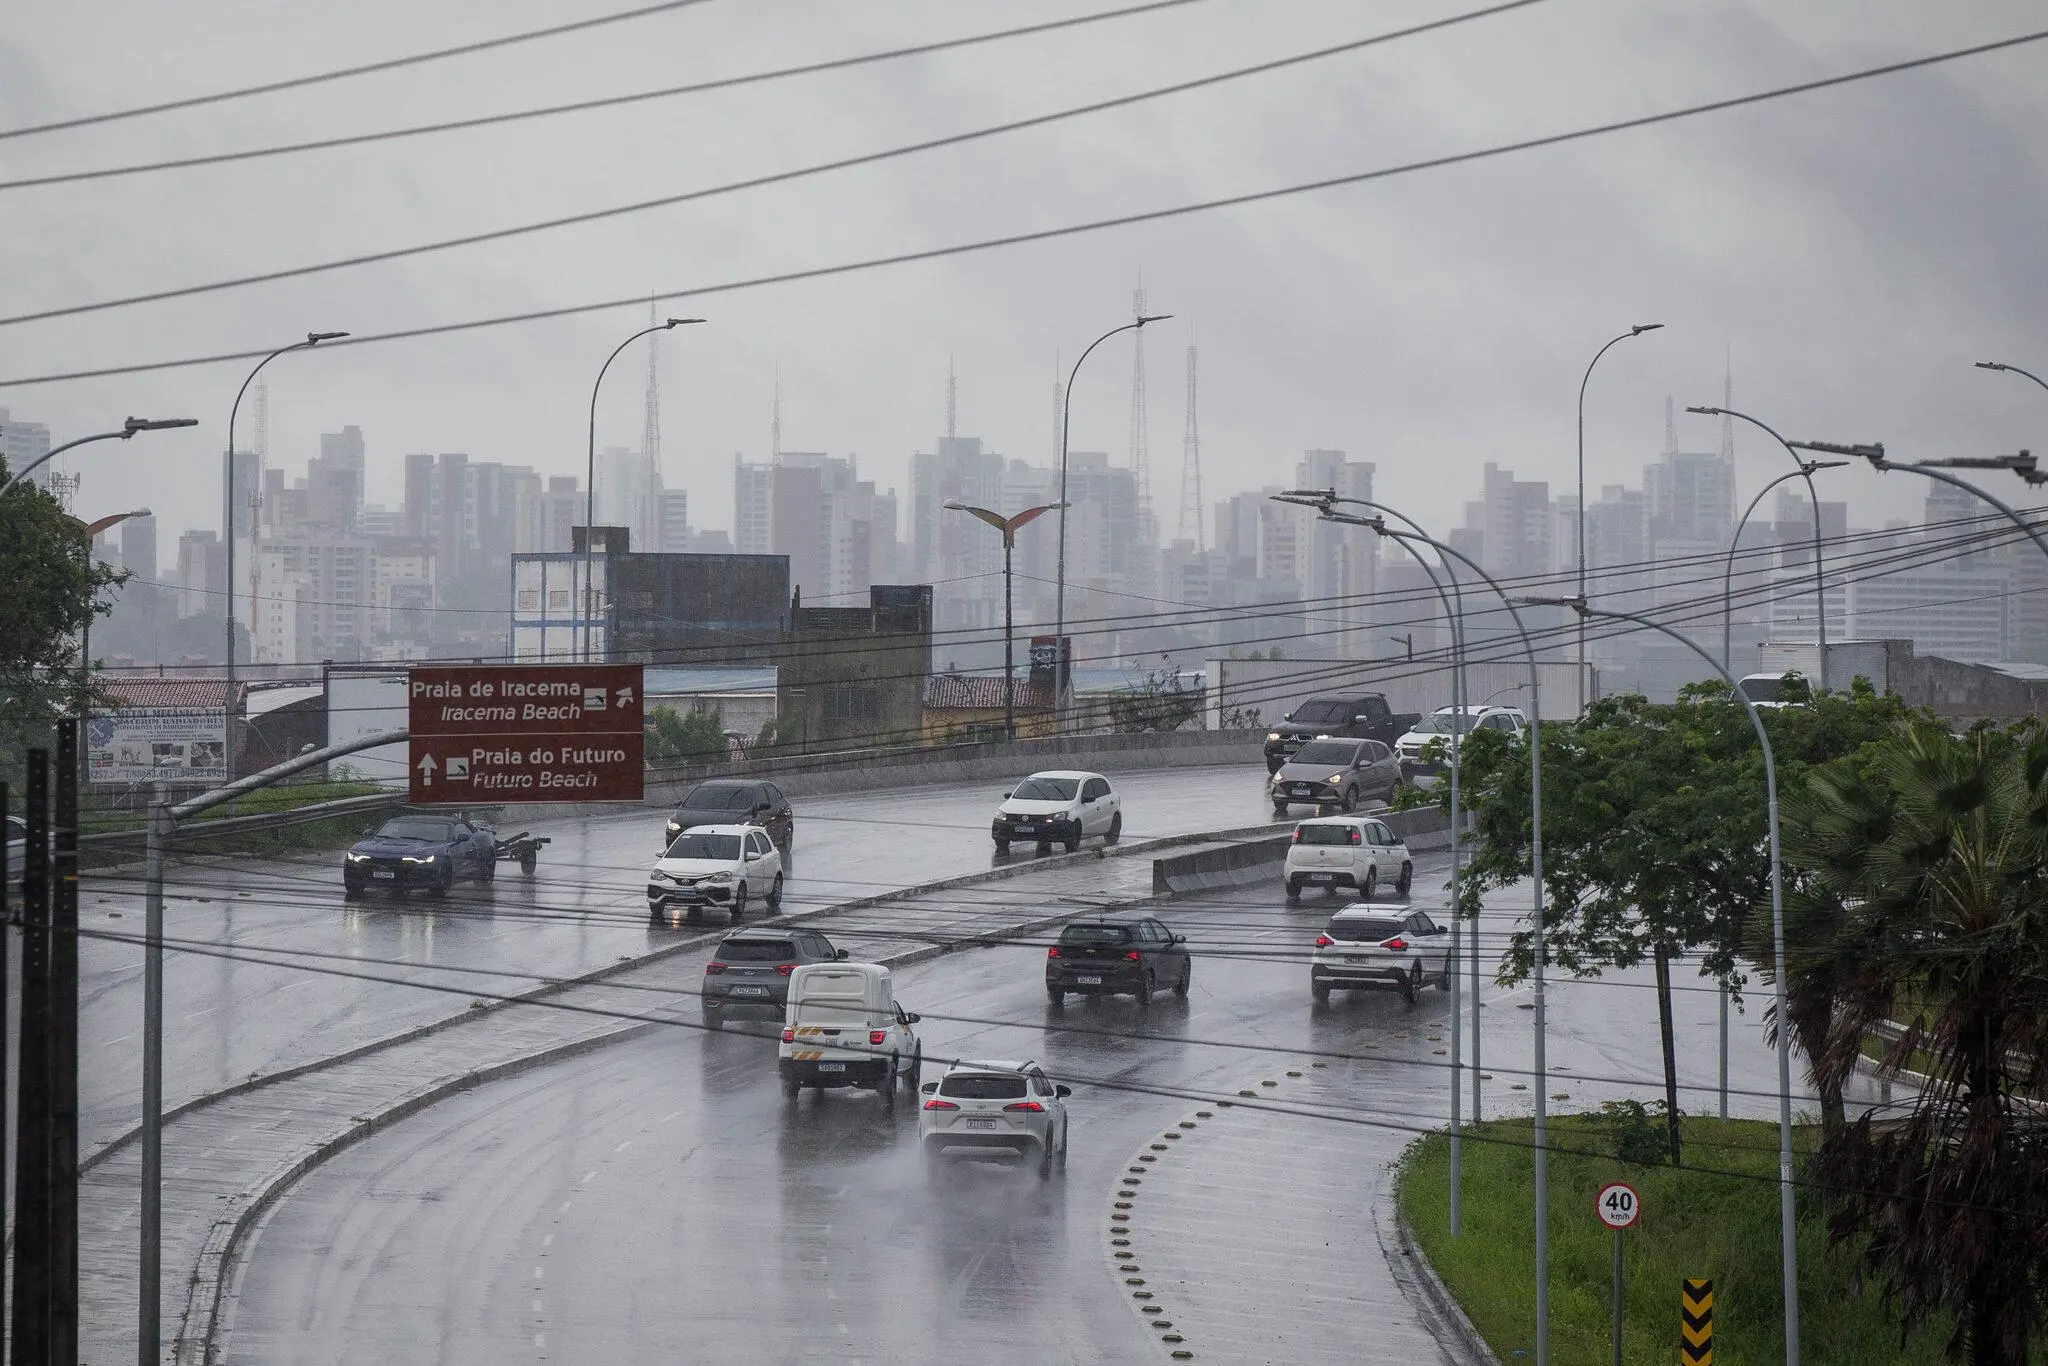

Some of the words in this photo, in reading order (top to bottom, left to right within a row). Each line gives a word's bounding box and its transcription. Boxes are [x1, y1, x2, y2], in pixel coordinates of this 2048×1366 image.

[412, 680, 462, 698] Praia
[469, 680, 494, 697] de
[501, 680, 581, 697] Iracema
[441, 705, 516, 721] Iracema
[522, 703, 581, 720] Beach
[472, 748, 522, 765] Praia
[529, 748, 554, 764] do
[561, 748, 626, 764] Futuro
[473, 772, 533, 788] Futuro
[539, 771, 598, 788] Beach
[1605, 1192, 1632, 1211] 40
[1610, 1212, 1630, 1220] km/h
